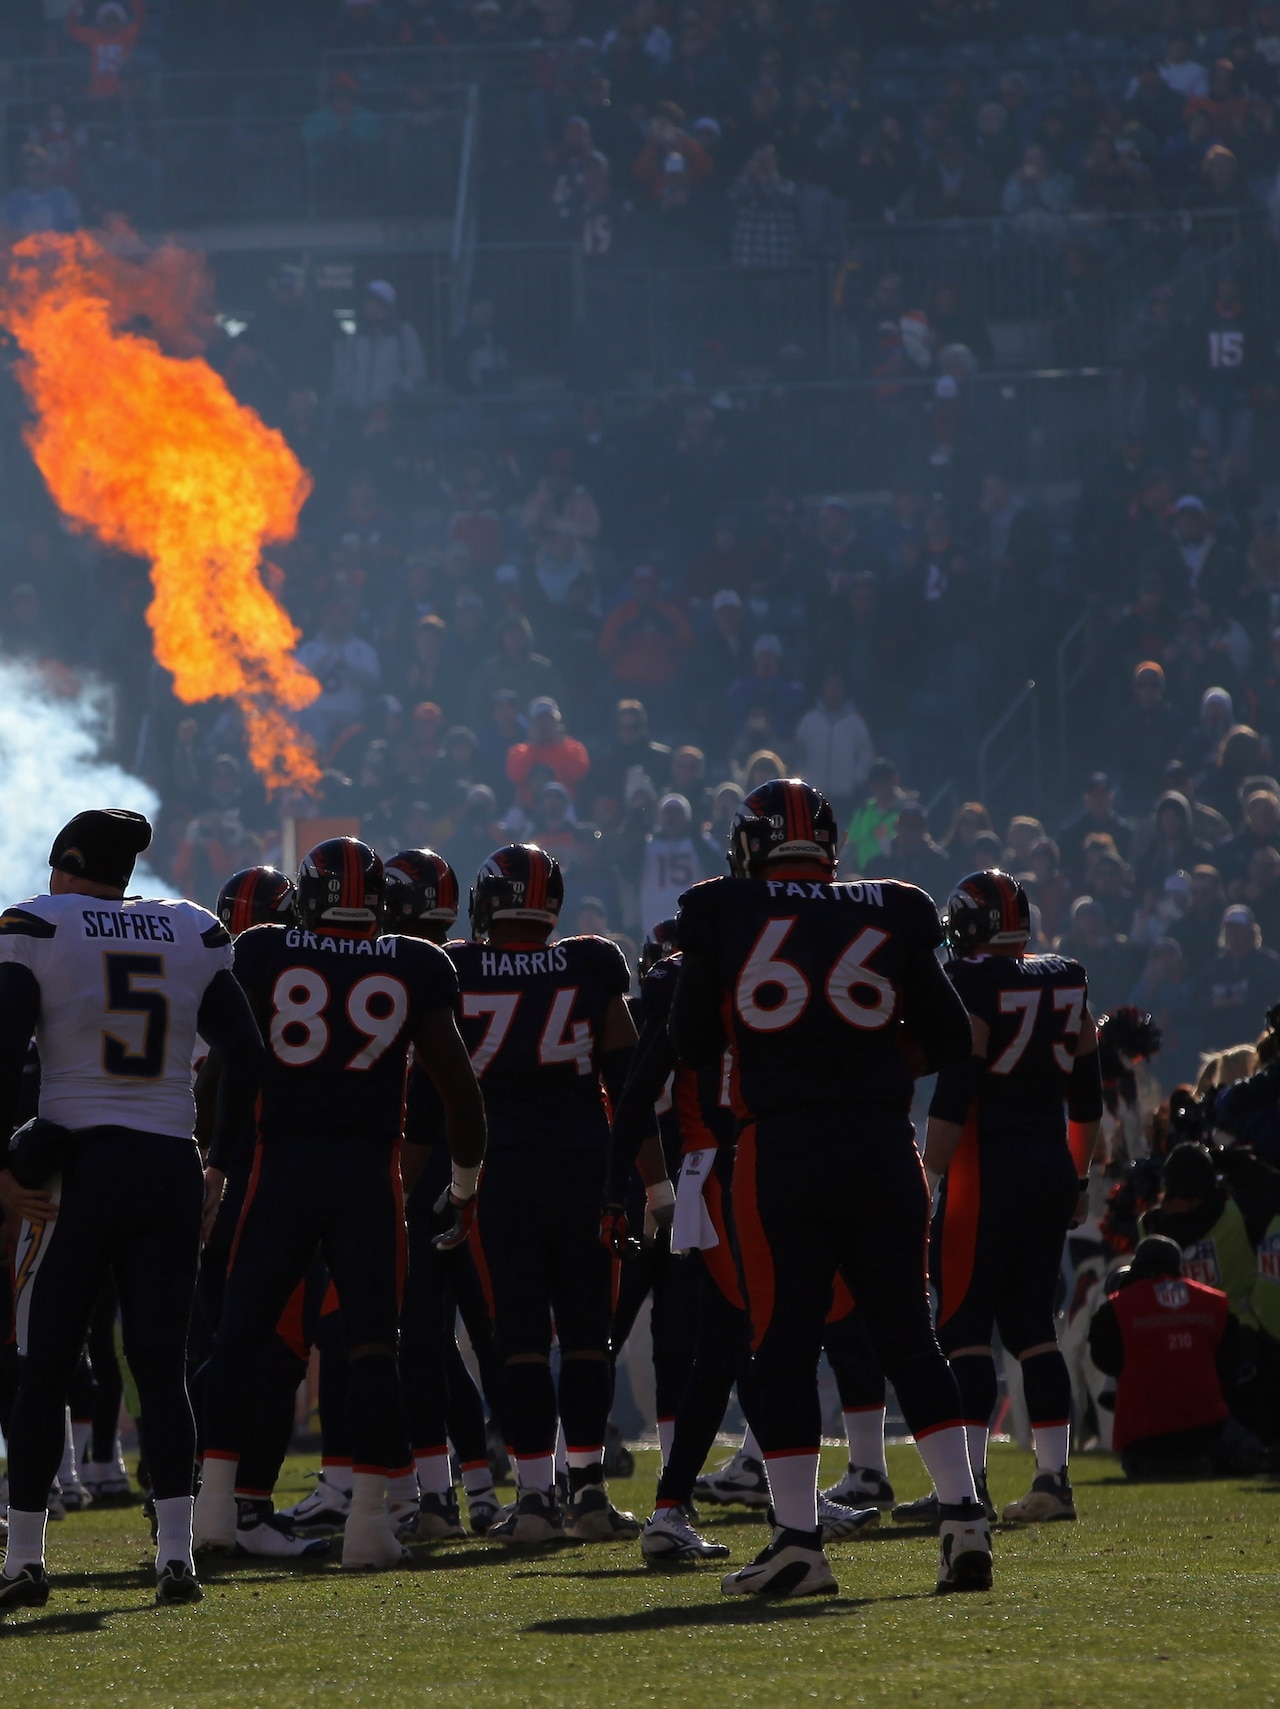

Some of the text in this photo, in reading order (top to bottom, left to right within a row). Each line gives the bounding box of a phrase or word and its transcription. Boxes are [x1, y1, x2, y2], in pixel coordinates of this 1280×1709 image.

[1209, 331, 1244, 368] 15
[770, 831, 784, 840] 66
[657, 853, 692, 888] 15
[328, 894, 340, 903] 89
[766, 881, 884, 907] PAXTON
[82, 910, 175, 943] SCIFRES
[285, 929, 397, 958] GRAHAM
[481, 946, 568, 977] HARRIS
[735, 914, 897, 1033] 66
[101, 951, 170, 1082] 5
[270, 964, 411, 1072] 89
[460, 985, 595, 1079] 74
[987, 986, 1087, 1076] 73
[1168, 1332, 1192, 1350] 210
